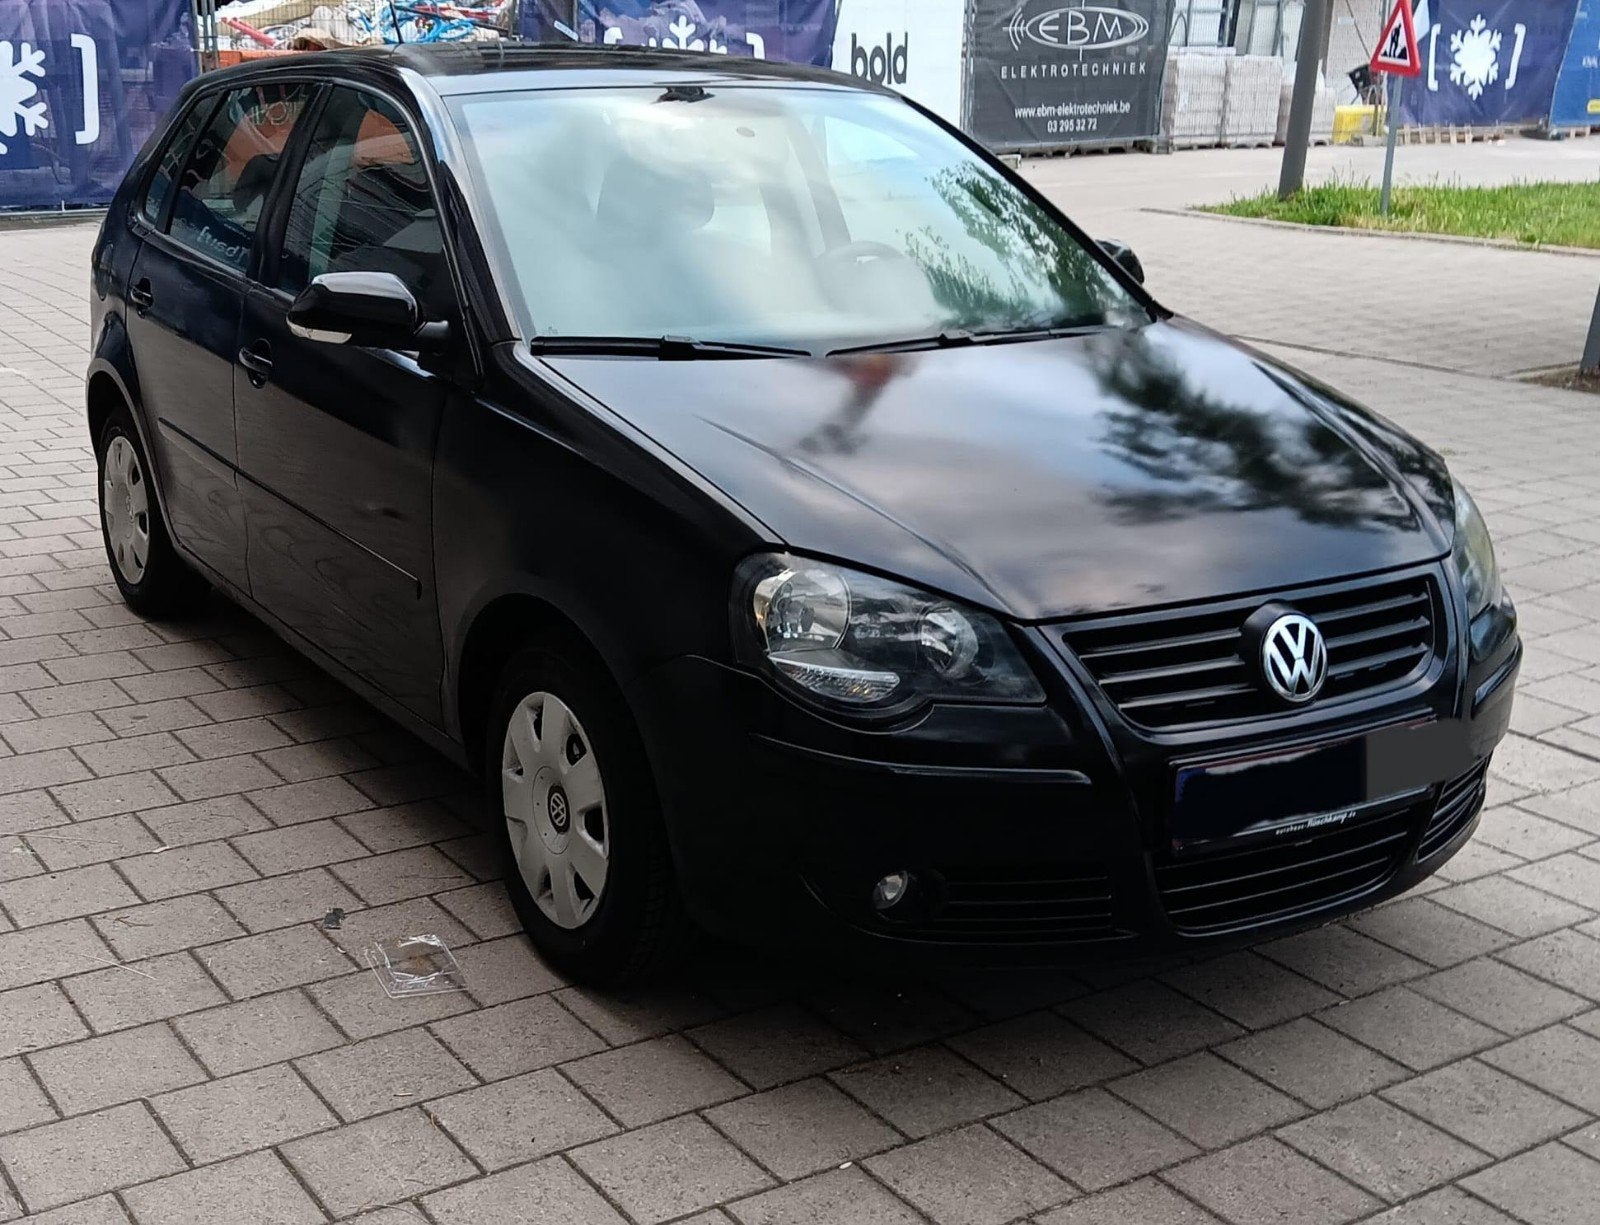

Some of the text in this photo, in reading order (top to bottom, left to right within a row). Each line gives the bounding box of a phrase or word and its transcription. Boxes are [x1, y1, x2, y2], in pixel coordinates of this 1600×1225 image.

[1038, 10, 1122, 45] EBM
[851, 31, 908, 85] bold
[1001, 62, 1146, 80] ELEKTROTECHNIEK
[1014, 100, 1130, 118] www.ebm-elektrotechniek.be
[1047, 120, 1057, 133] 03
[1075, 118, 1086, 132] 32
[1087, 118, 1097, 131] 72
